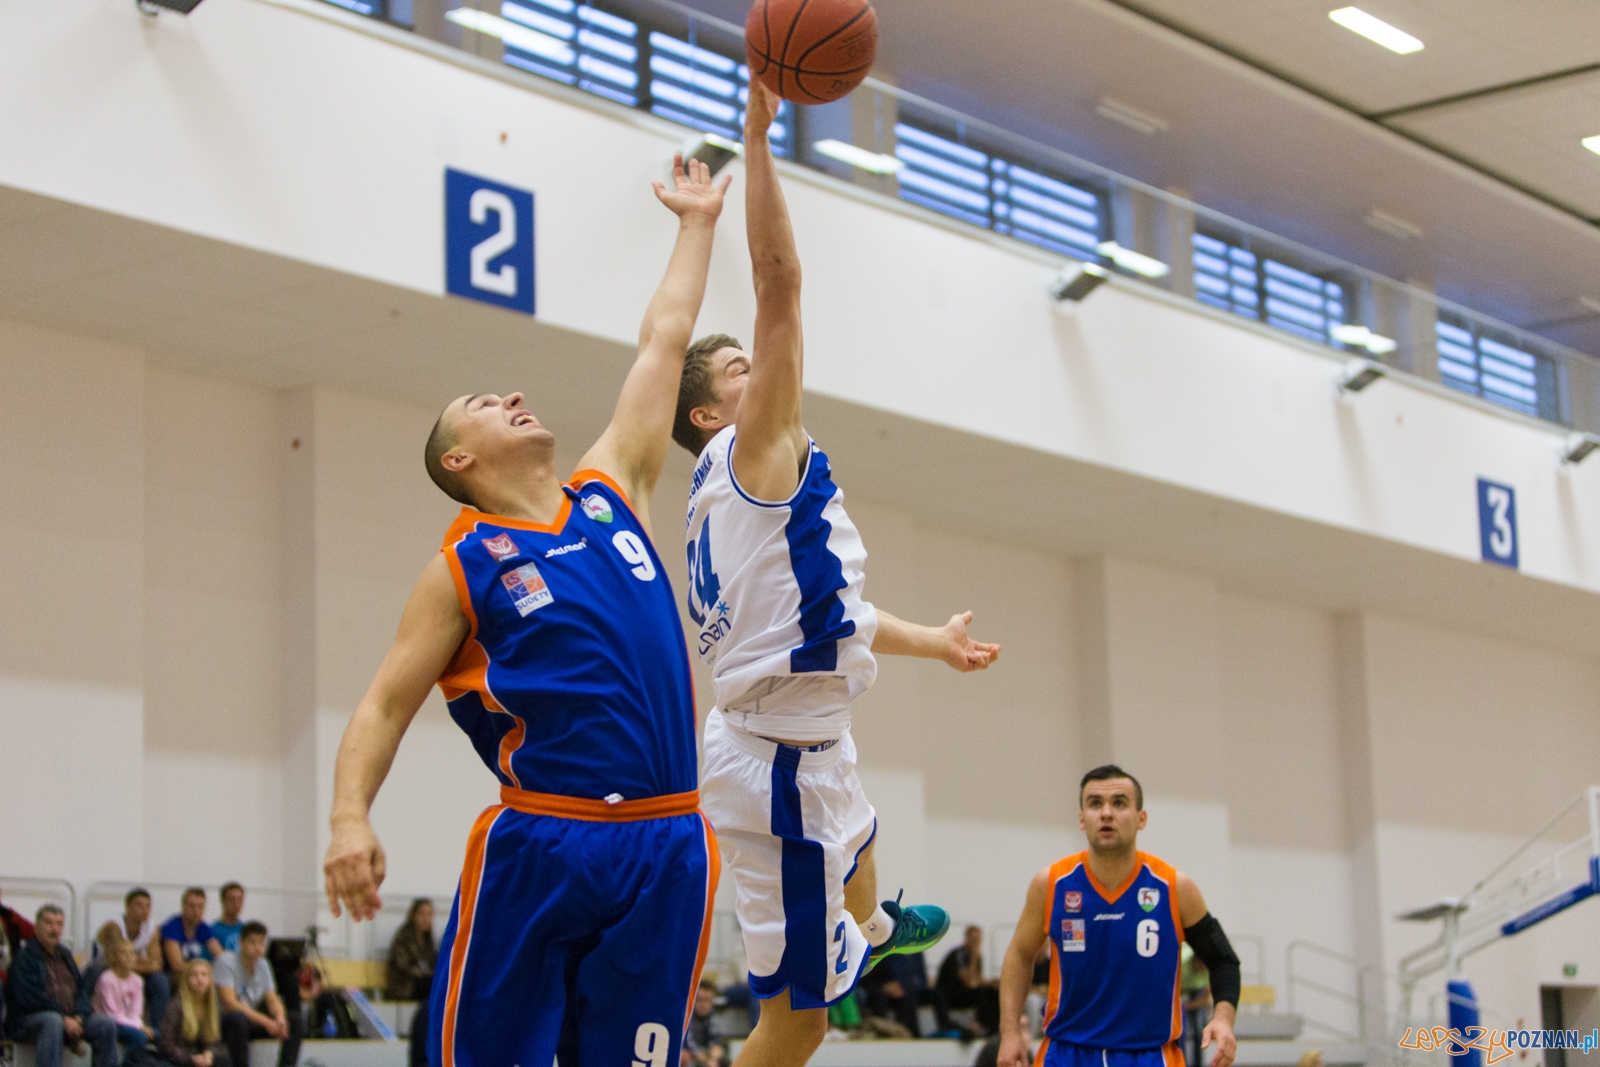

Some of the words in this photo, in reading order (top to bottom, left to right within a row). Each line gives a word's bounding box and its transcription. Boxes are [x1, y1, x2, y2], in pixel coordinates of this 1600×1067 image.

[470, 188, 517, 298] 2
[1487, 486, 1513, 558] 3
[611, 529, 656, 582] 9
[516, 590, 549, 610] SUDETY
[833, 920, 849, 975] 2
[1135, 918, 1160, 958] 6
[631, 1022, 670, 1067] 9
